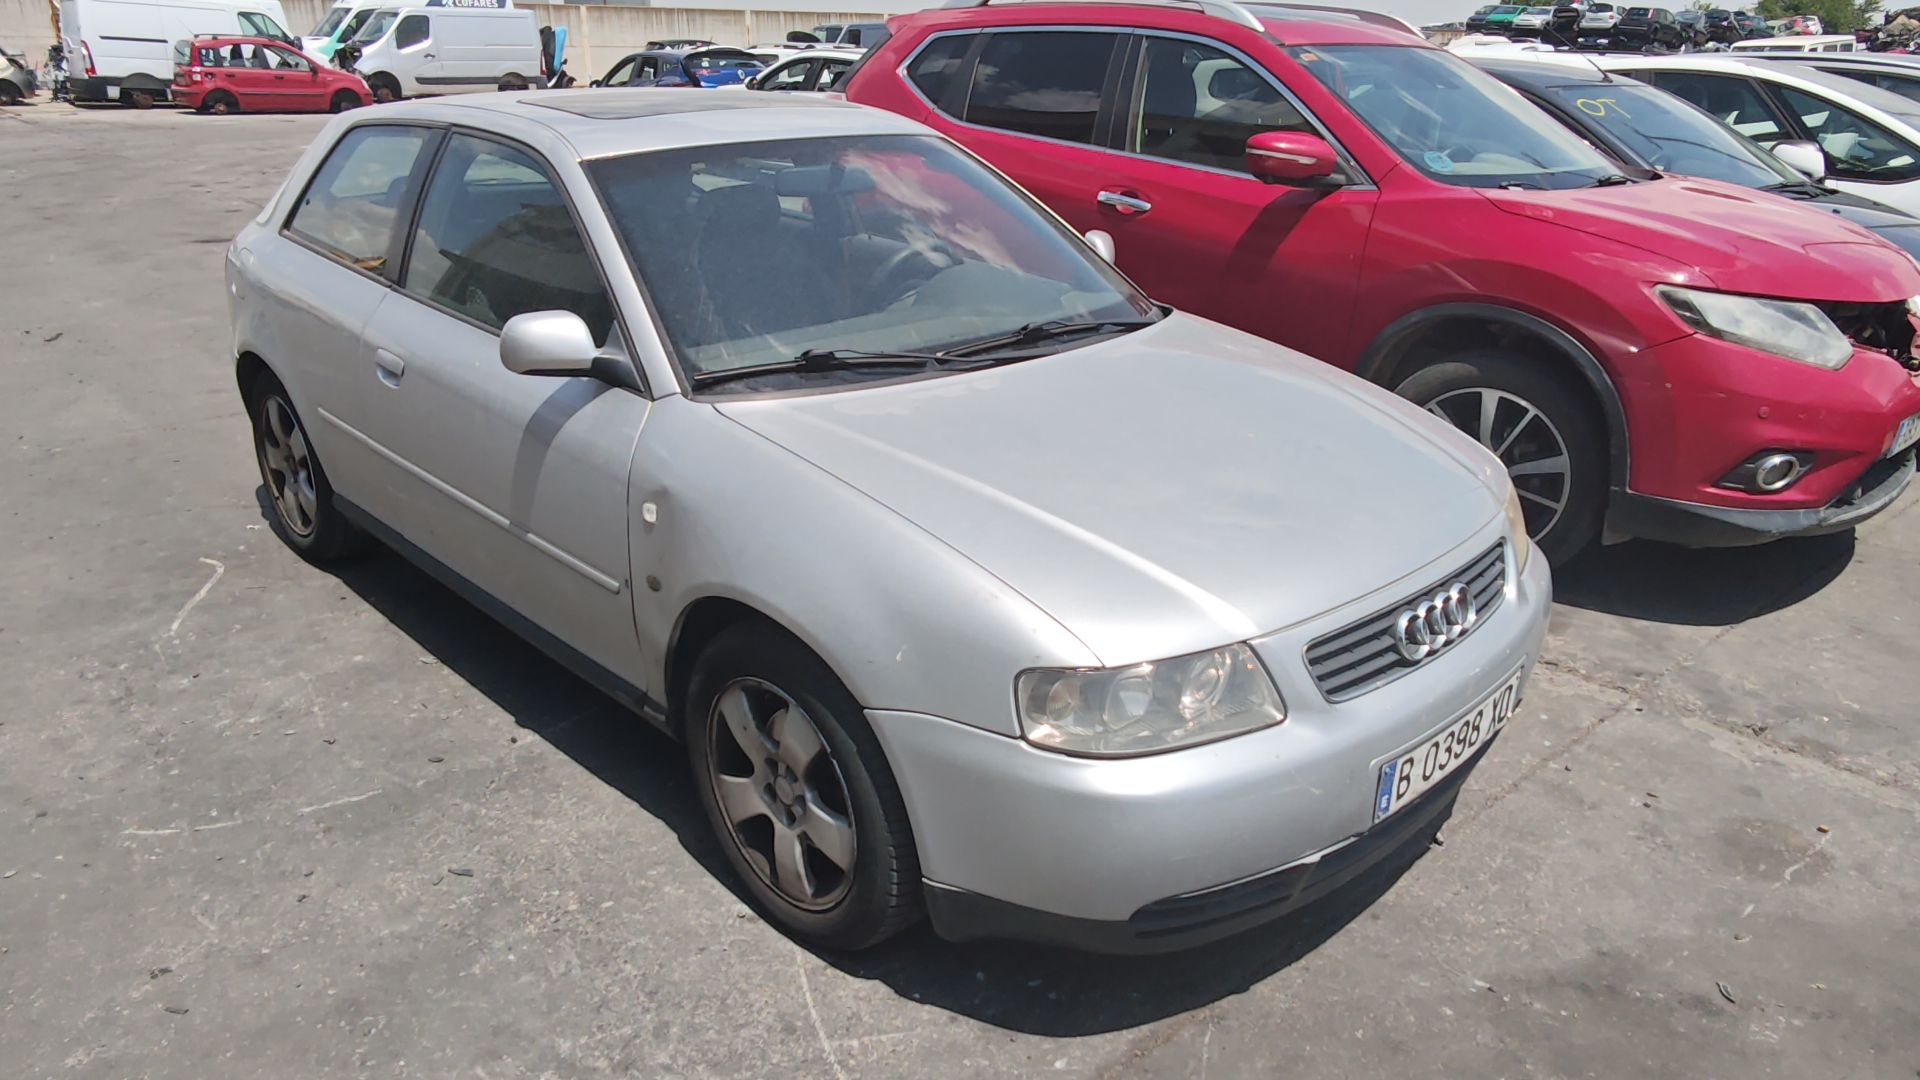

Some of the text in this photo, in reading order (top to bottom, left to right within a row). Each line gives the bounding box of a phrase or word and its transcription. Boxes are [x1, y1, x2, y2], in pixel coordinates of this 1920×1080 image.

[455, 0, 499, 8] COFARES
[1396, 757, 1415, 801] B
[1421, 708, 1484, 782] 0398
